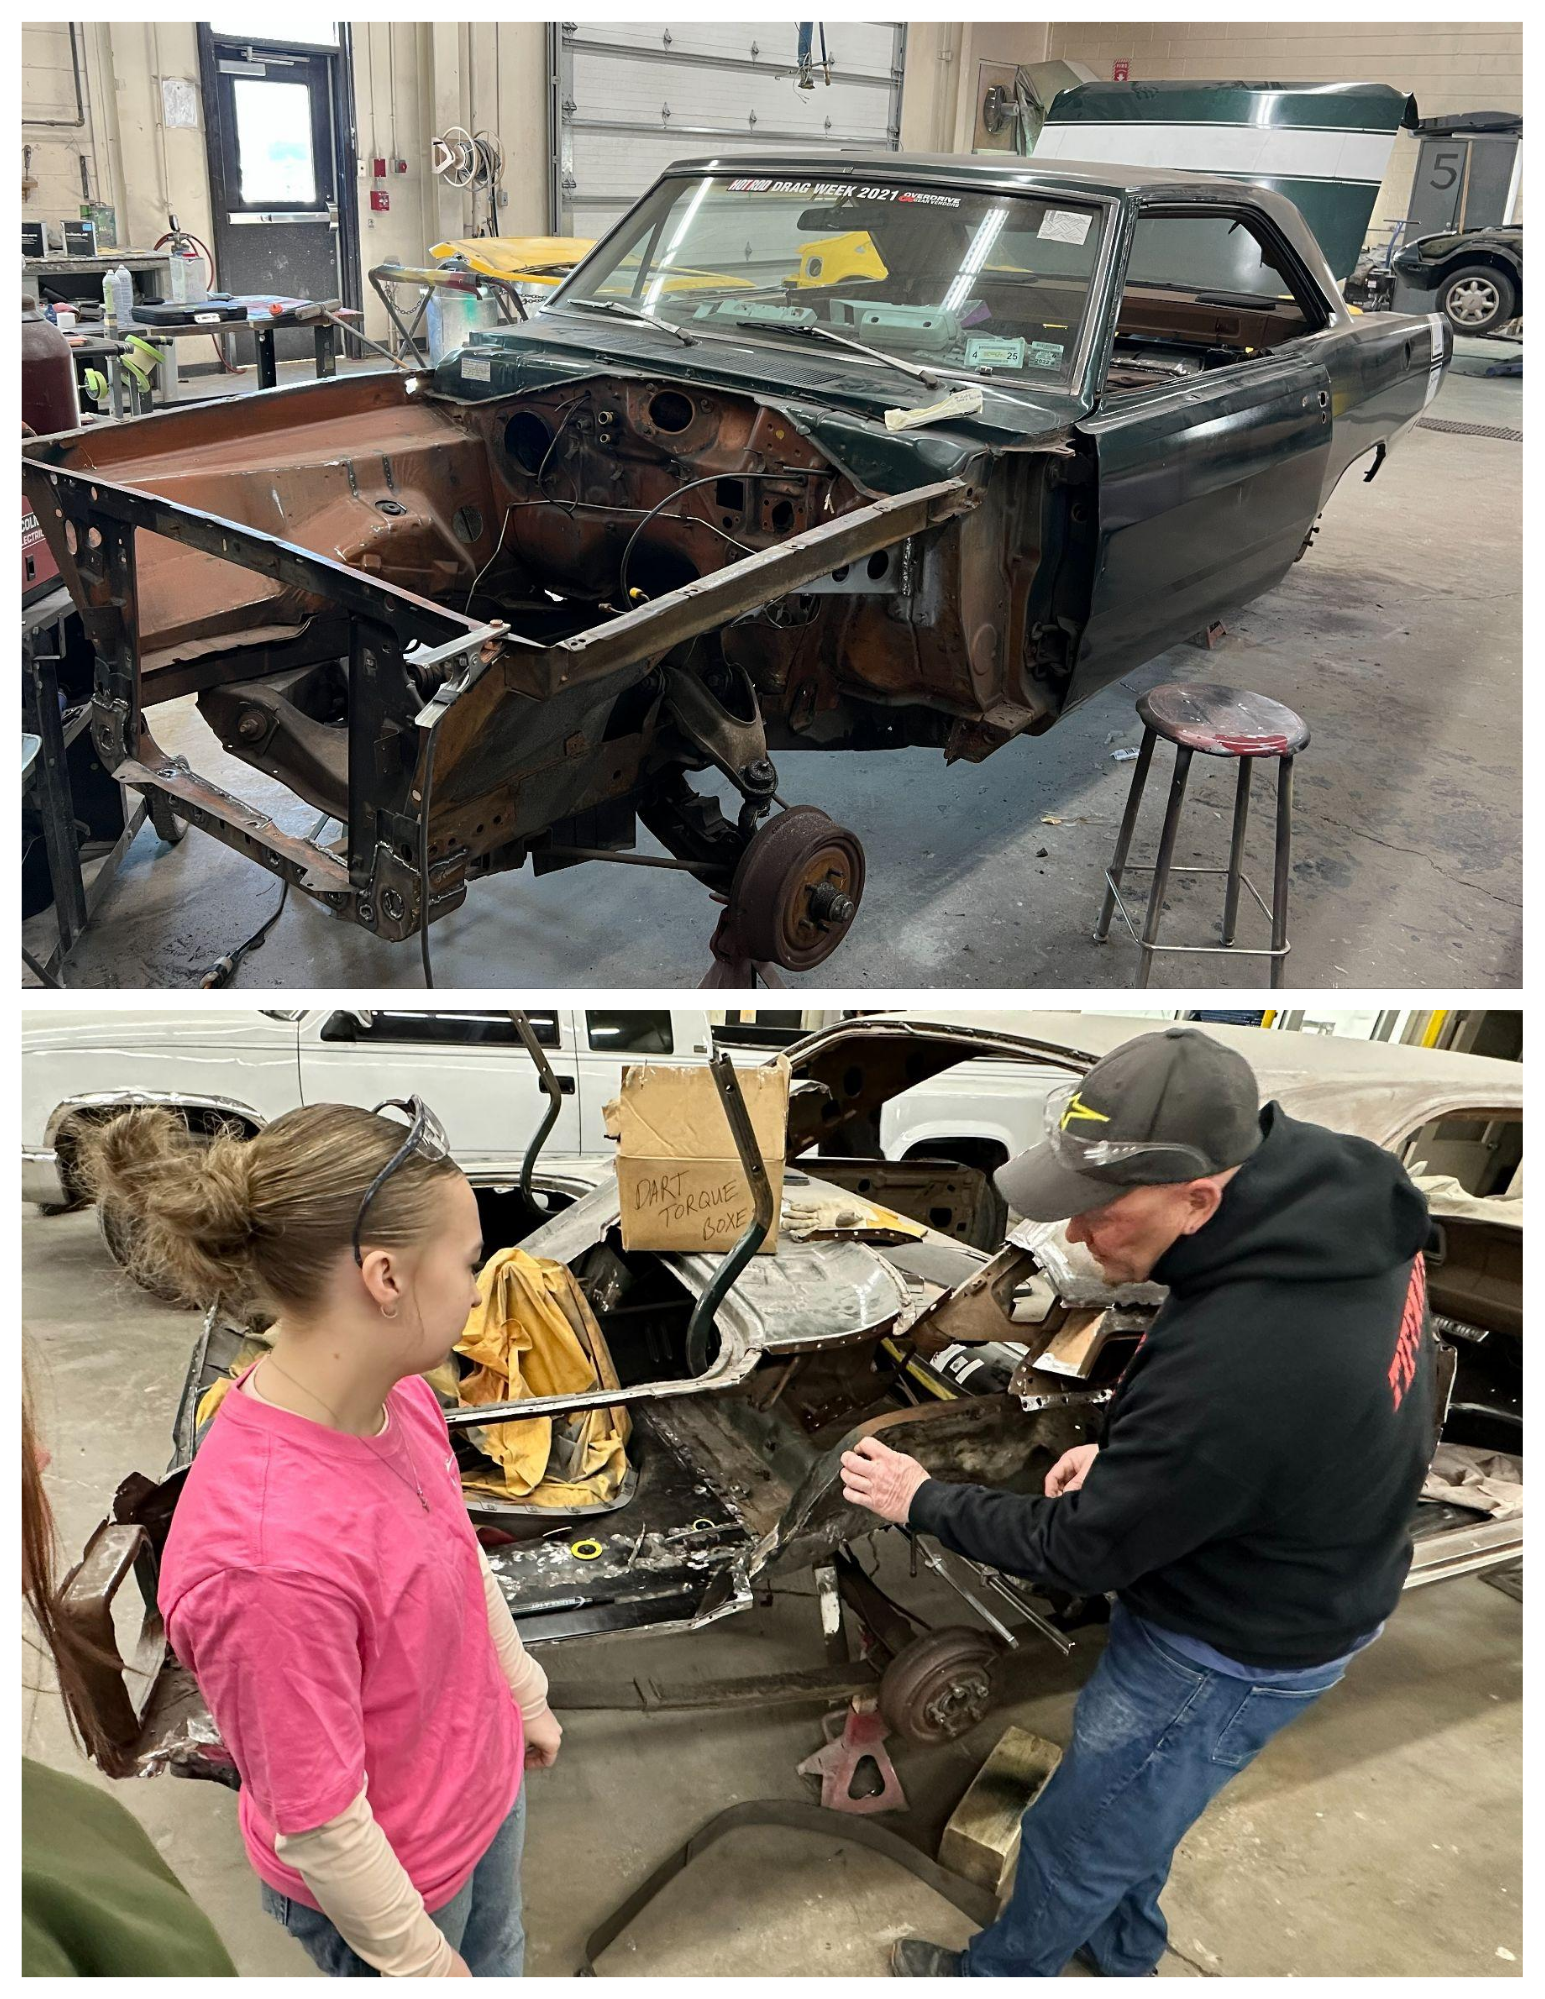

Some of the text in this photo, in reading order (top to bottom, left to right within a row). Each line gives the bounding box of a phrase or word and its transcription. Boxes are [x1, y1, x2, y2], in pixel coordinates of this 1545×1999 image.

[1430, 153, 1459, 190] 5
[728, 179, 753, 191] HOT
[747, 179, 773, 192] ROD
[770, 181, 811, 194] DRAG
[813, 183, 858, 197] WEEK
[857, 187, 899, 201] 2021
[904, 192, 961, 204] OVERDRIVE
[972, 351, 978, 359] 4
[1007, 352, 1018, 360] 25
[22, 529, 44, 546] ECTRI
[635, 1170, 690, 1211] DART
[658, 1179, 739, 1228] TORQUE
[702, 1207, 755, 1241] BOXE
